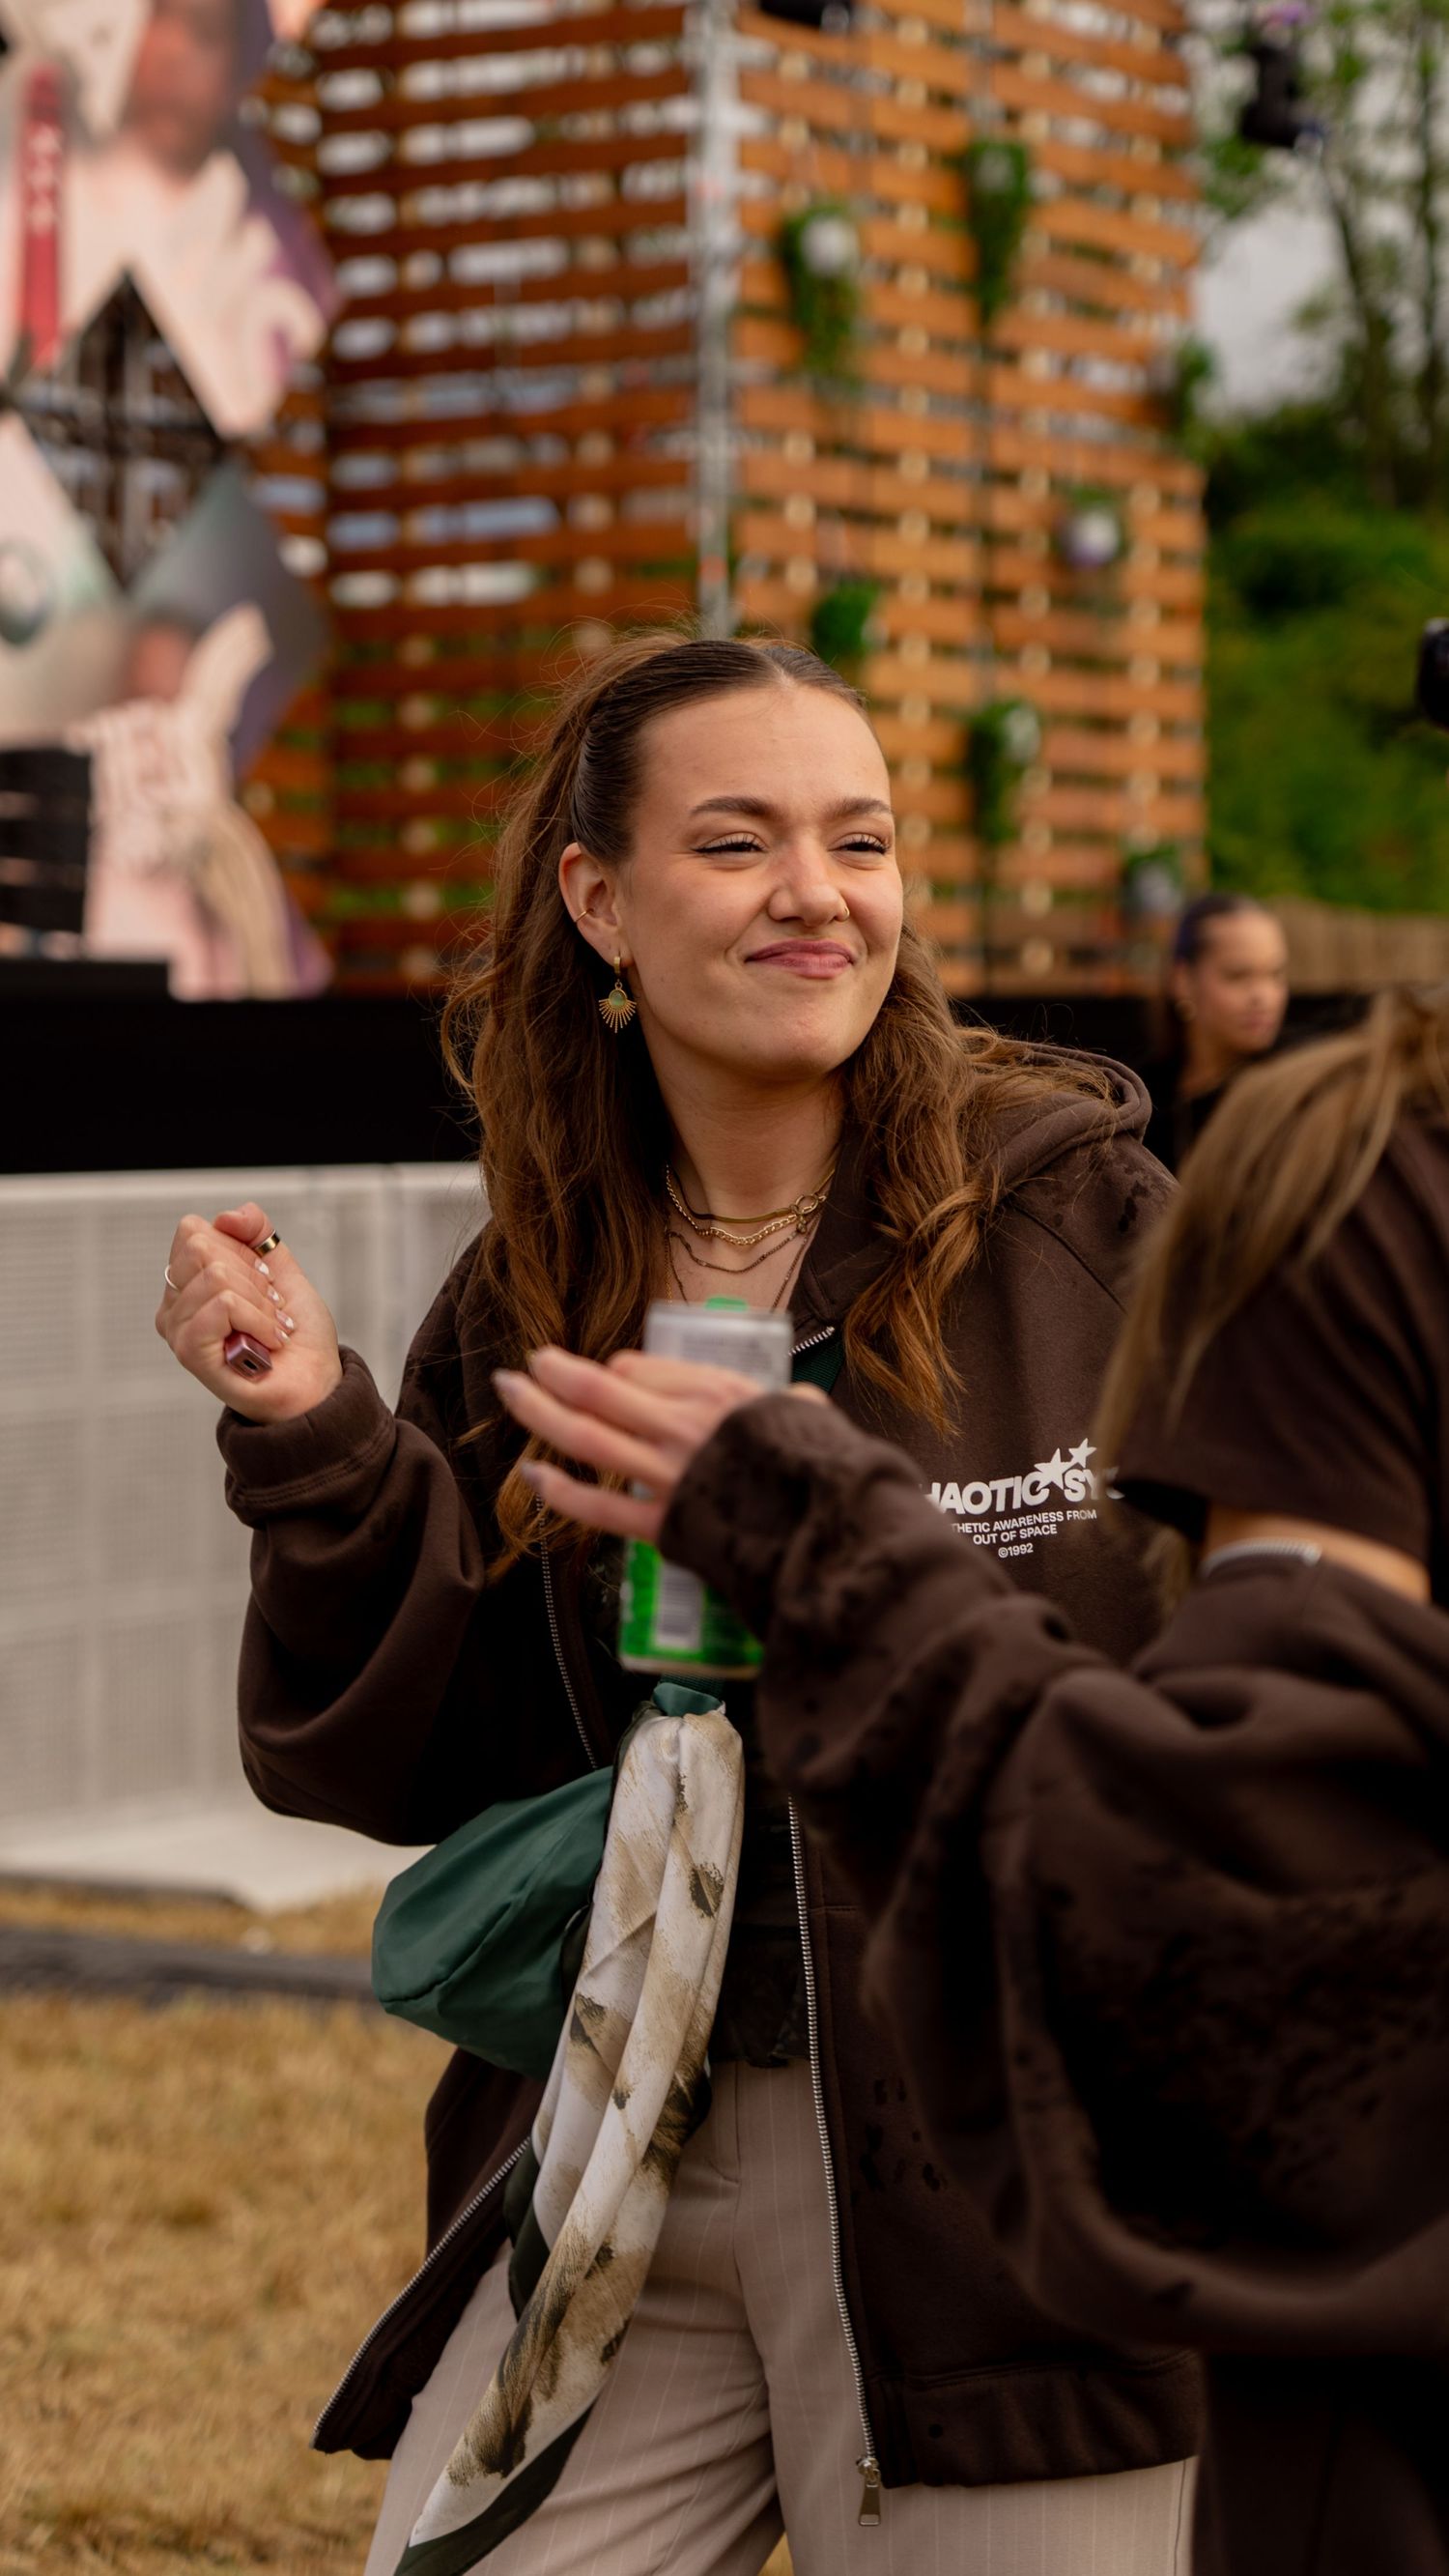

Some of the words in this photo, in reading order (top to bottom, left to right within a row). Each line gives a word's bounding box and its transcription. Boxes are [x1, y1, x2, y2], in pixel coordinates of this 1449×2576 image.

[993, 1511, 1064, 1531] AWARENESS
[1066, 1509, 1097, 1521] FROM
[973, 1533, 998, 1545] OUT
[1001, 1531, 1016, 1542] OF
[1019, 1524, 1058, 1539] SPACE
[998, 1542, 1034, 1559] ©1992
